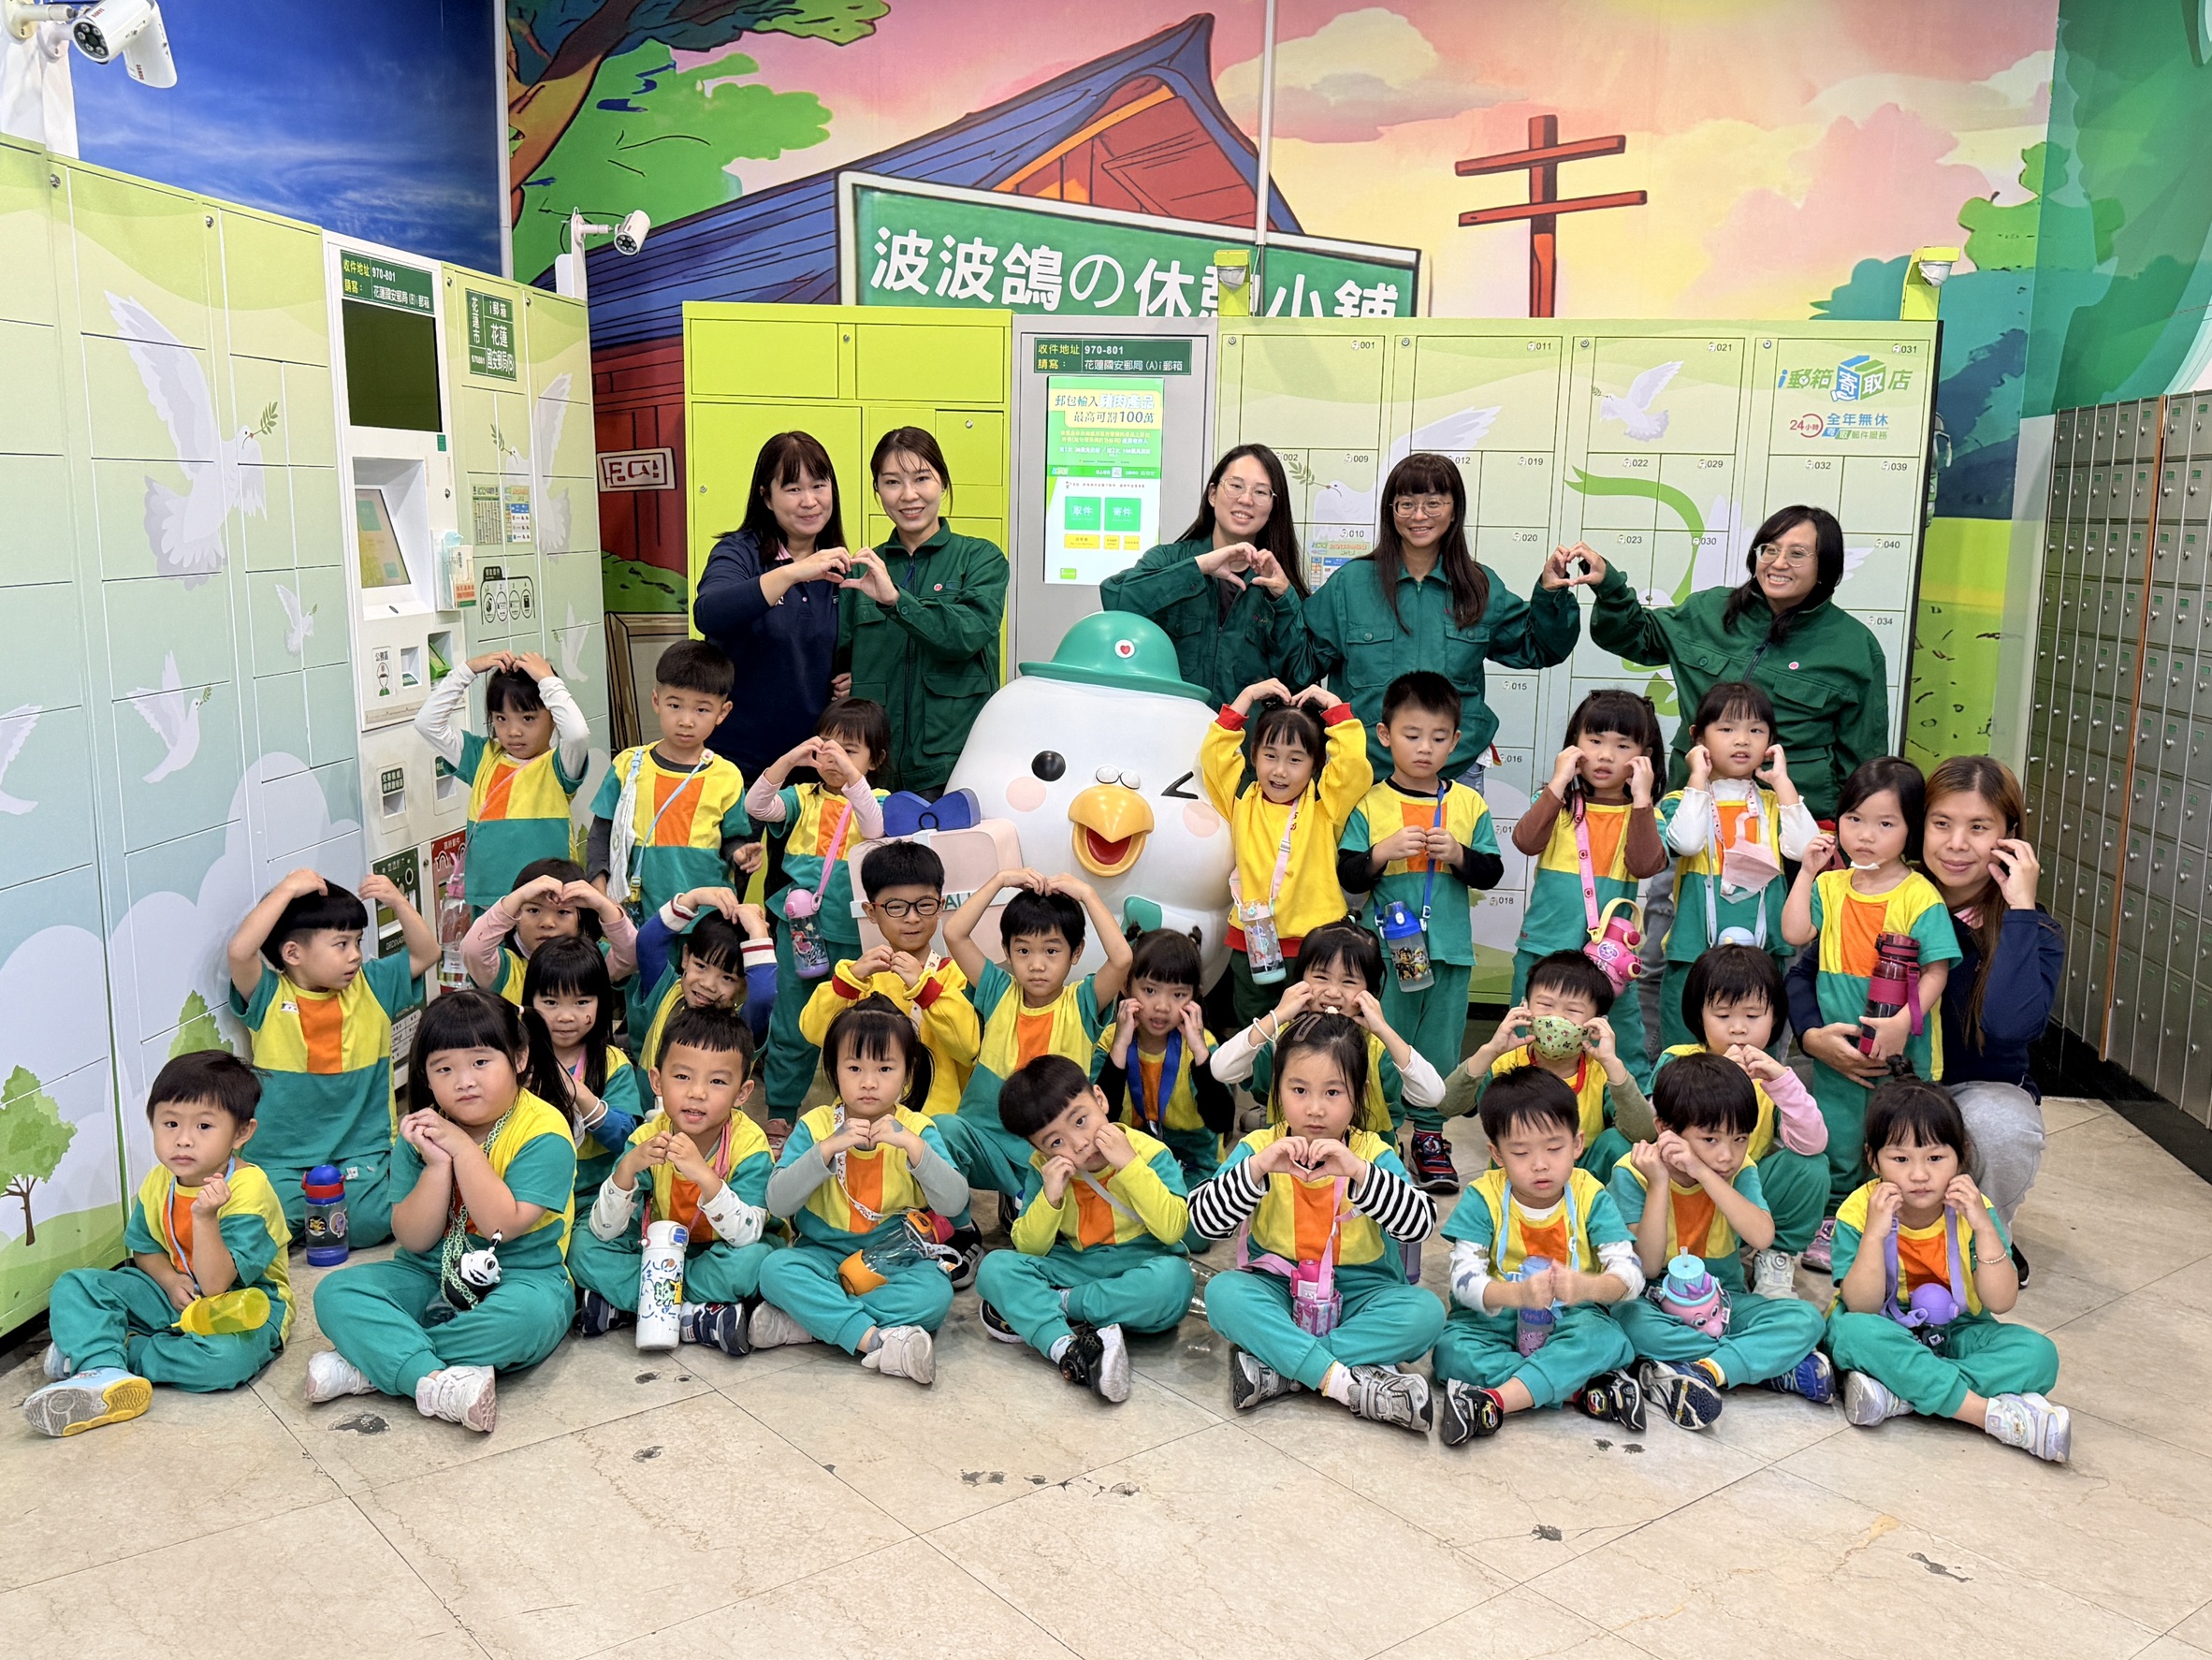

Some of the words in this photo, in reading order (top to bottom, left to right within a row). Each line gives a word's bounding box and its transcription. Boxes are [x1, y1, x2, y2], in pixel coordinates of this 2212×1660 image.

[371, 267, 396, 283] 970-801
[1038, 343, 1080, 355] 收件地址
[1360, 341, 1375, 349] 001
[1716, 343, 1732, 352] 021
[1900, 345, 1917, 354] 031
[1084, 345, 1124, 355] 970-801
[1826, 413, 1888, 426] 全年無休
[1283, 453, 1299, 461] 002
[1353, 455, 1369, 463] 009
[1454, 457, 1471, 465] 012
[1527, 458, 1544, 466] 019
[1632, 459, 1649, 467] 022
[1707, 459, 1724, 469] 029
[1814, 461, 1831, 470] 032
[1890, 462, 1908, 471] 039
[1348, 530, 1364, 538] 010
[1521, 533, 1538, 542] 020
[1626, 535, 1643, 545] 023
[1700, 537, 1717, 546] 030
[1884, 541, 1900, 549] 040
[1876, 618, 1893, 626] 034
[1511, 682, 1528, 691] 015
[1498, 896, 1514, 905] 018
